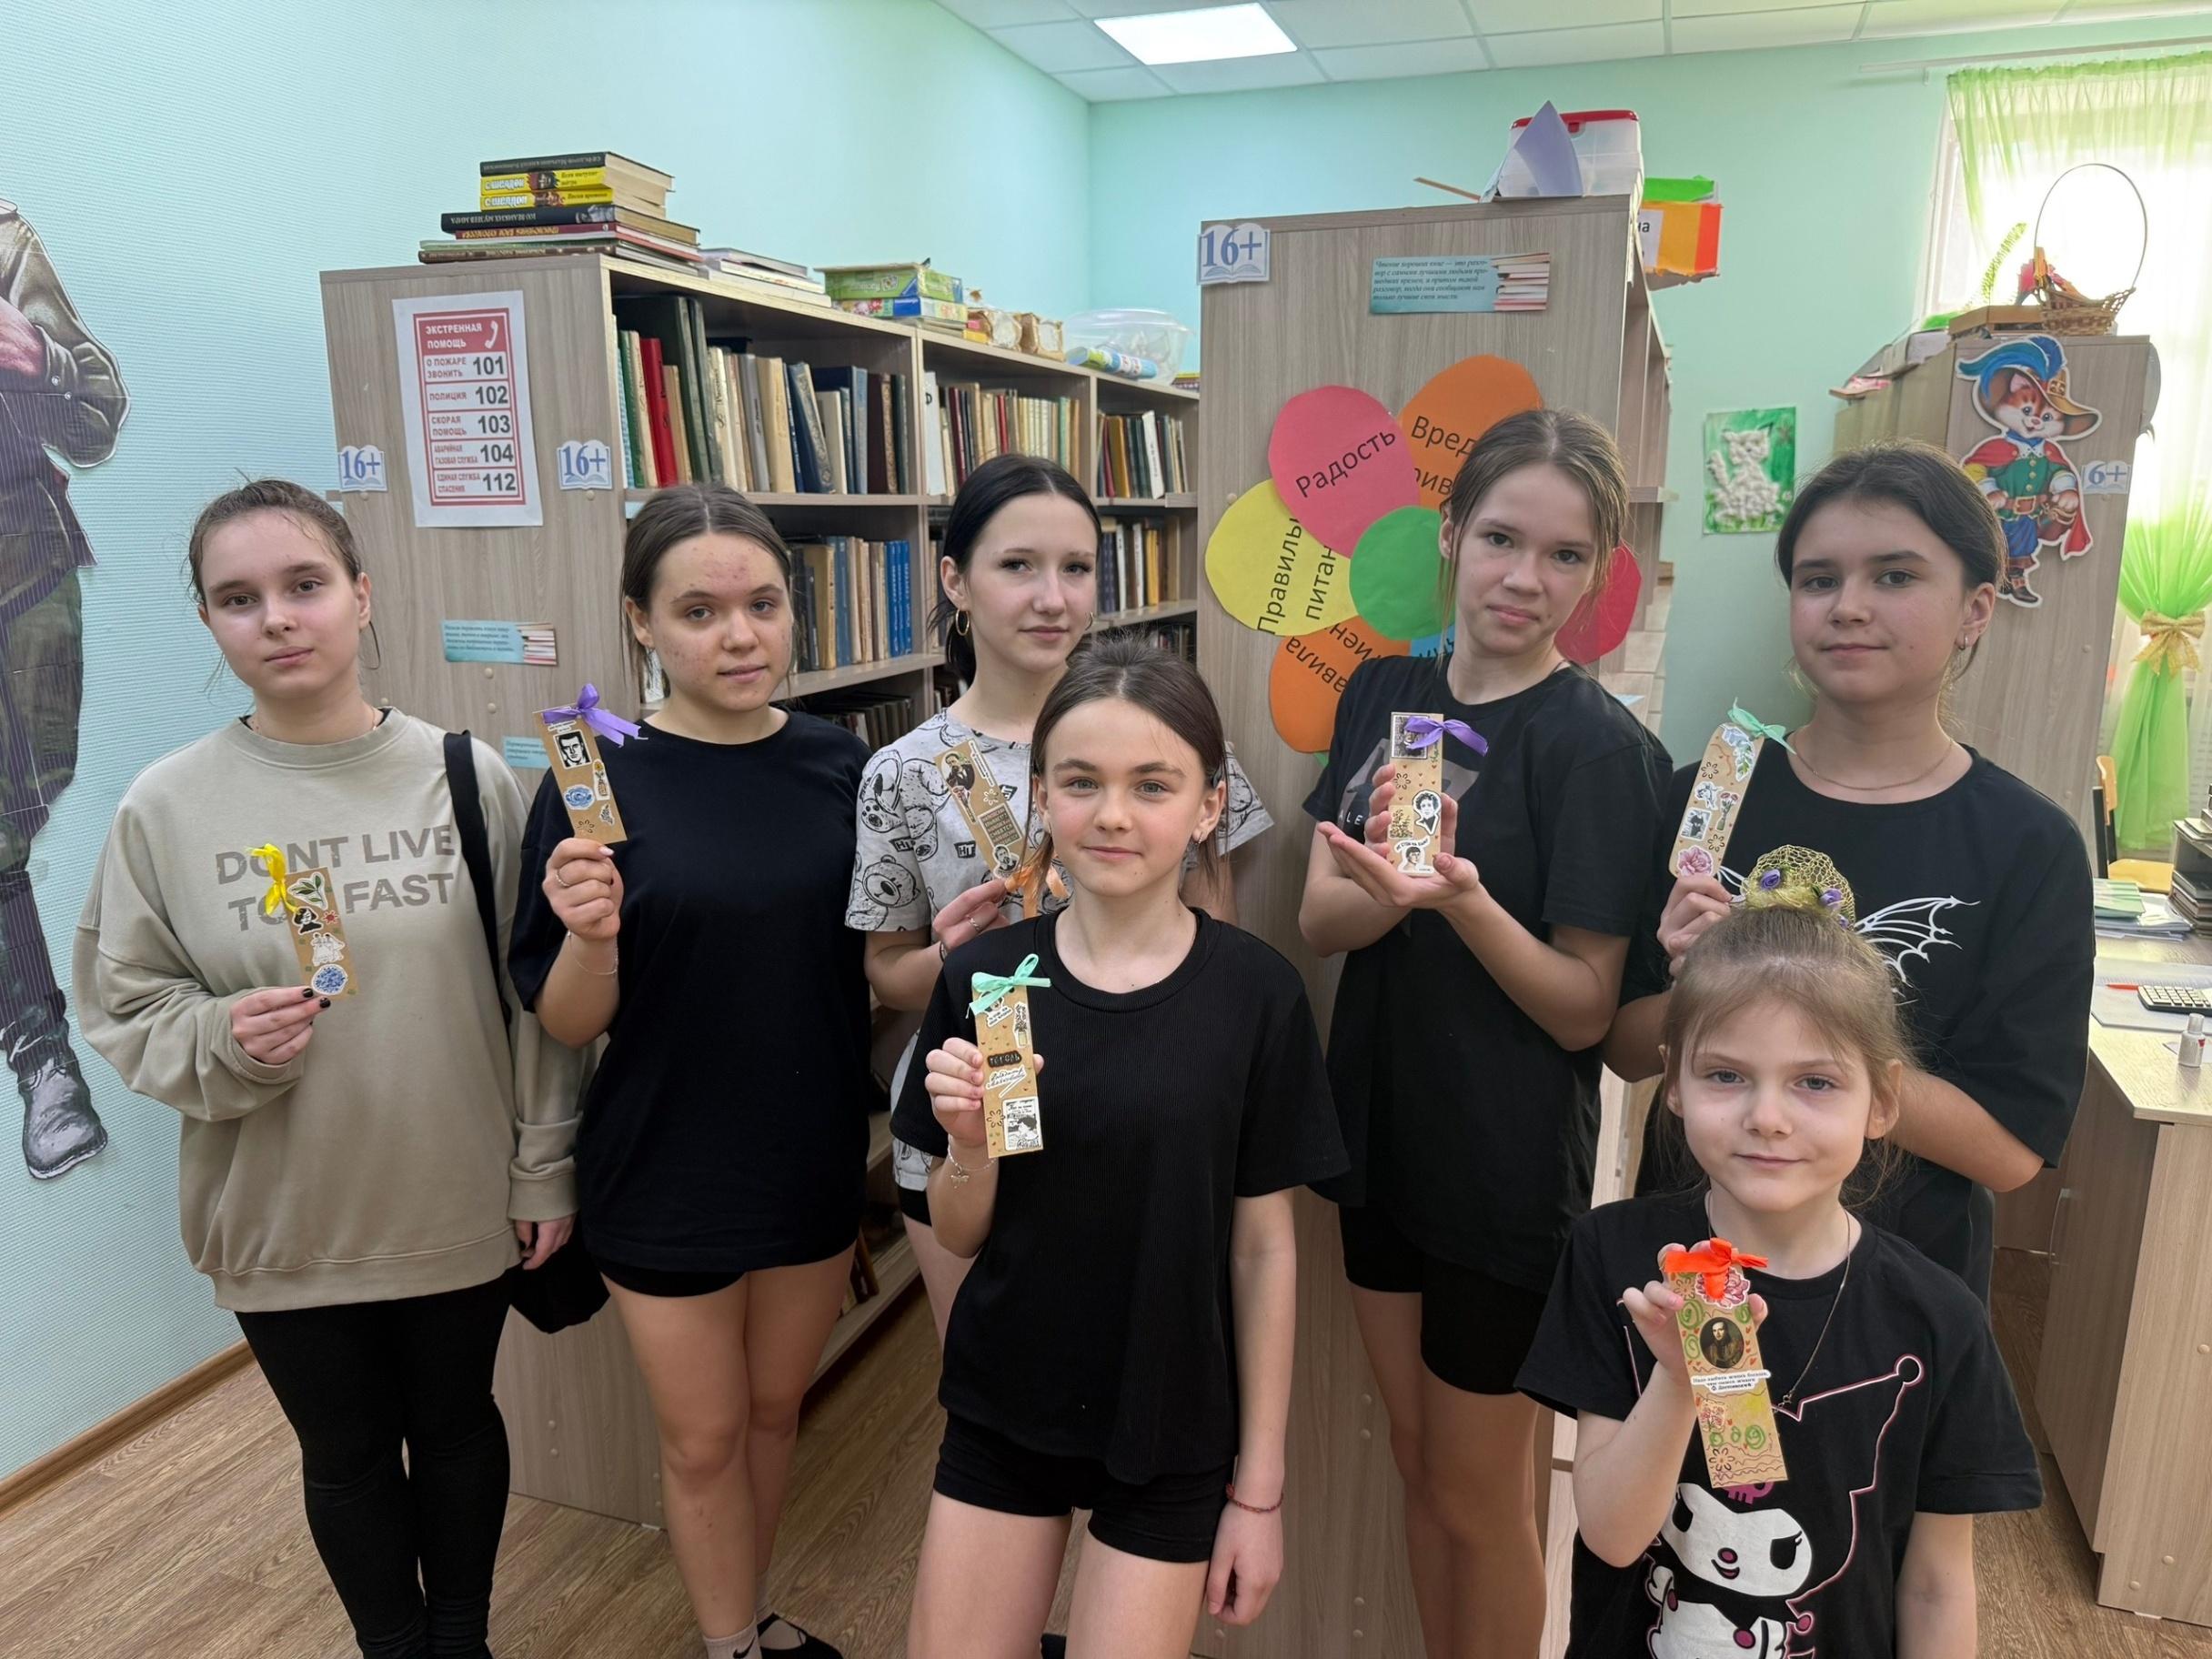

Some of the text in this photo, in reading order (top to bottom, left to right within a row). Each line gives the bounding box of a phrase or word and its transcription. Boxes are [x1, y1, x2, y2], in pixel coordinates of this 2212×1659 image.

[1201, 228, 1262, 267] 16+
[425, 322, 483, 335] ЭКСТРЕННАЯ
[427, 338, 467, 349] ПОМОЩЬ
[434, 357, 467, 367] ПОЖАРЕ
[473, 355, 506, 376] 101
[427, 369, 463, 379] ЗВОНИТЬ
[429, 391, 468, 402] ПОЛИЦИЯ
[475, 385, 508, 405] 102
[431, 416, 461, 425] СКОРАЯ
[478, 415, 511, 435] 103
[432, 427, 468, 437] ПОМОЩЬ
[480, 443, 514, 463] 104
[562, 445, 607, 477] 16+
[1295, 428, 1397, 498] Радость
[341, 449, 381, 479] 16+
[2087, 463, 2127, 485] 6+
[482, 472, 516, 491] 112
[362, 824, 456, 864] LIVE
[343, 872, 454, 915] FAST
